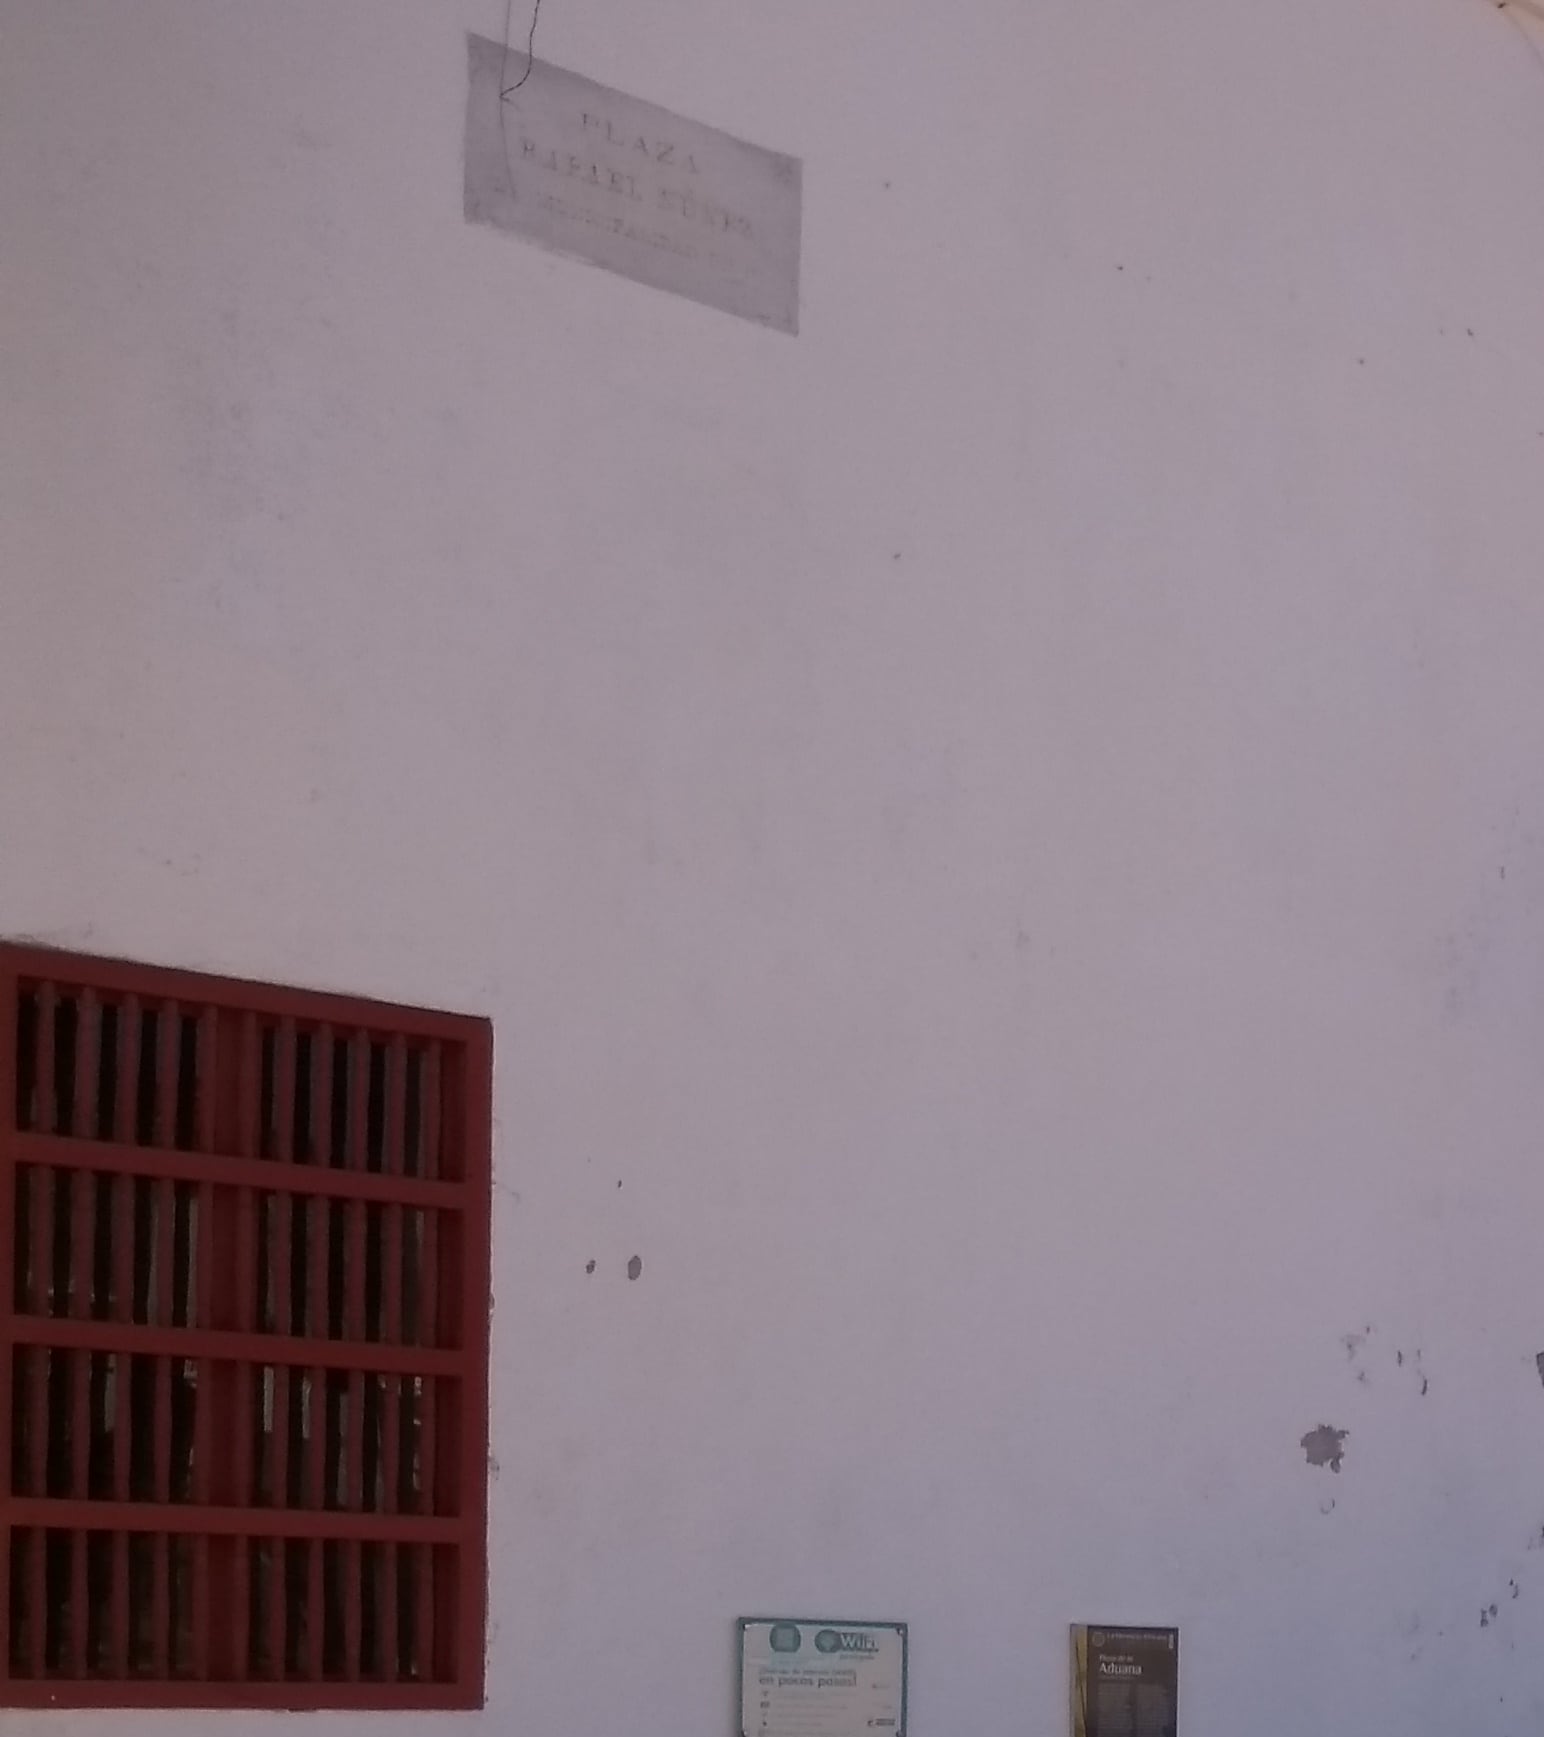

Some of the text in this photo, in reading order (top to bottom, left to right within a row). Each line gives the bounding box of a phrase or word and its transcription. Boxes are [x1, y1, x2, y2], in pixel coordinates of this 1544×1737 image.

[581, 112, 702, 176] PLAZA
[1099, 1662, 1142, 1675] Aduana
[759, 1676, 774, 1685] en
[778, 1676, 813, 1688] pocos
